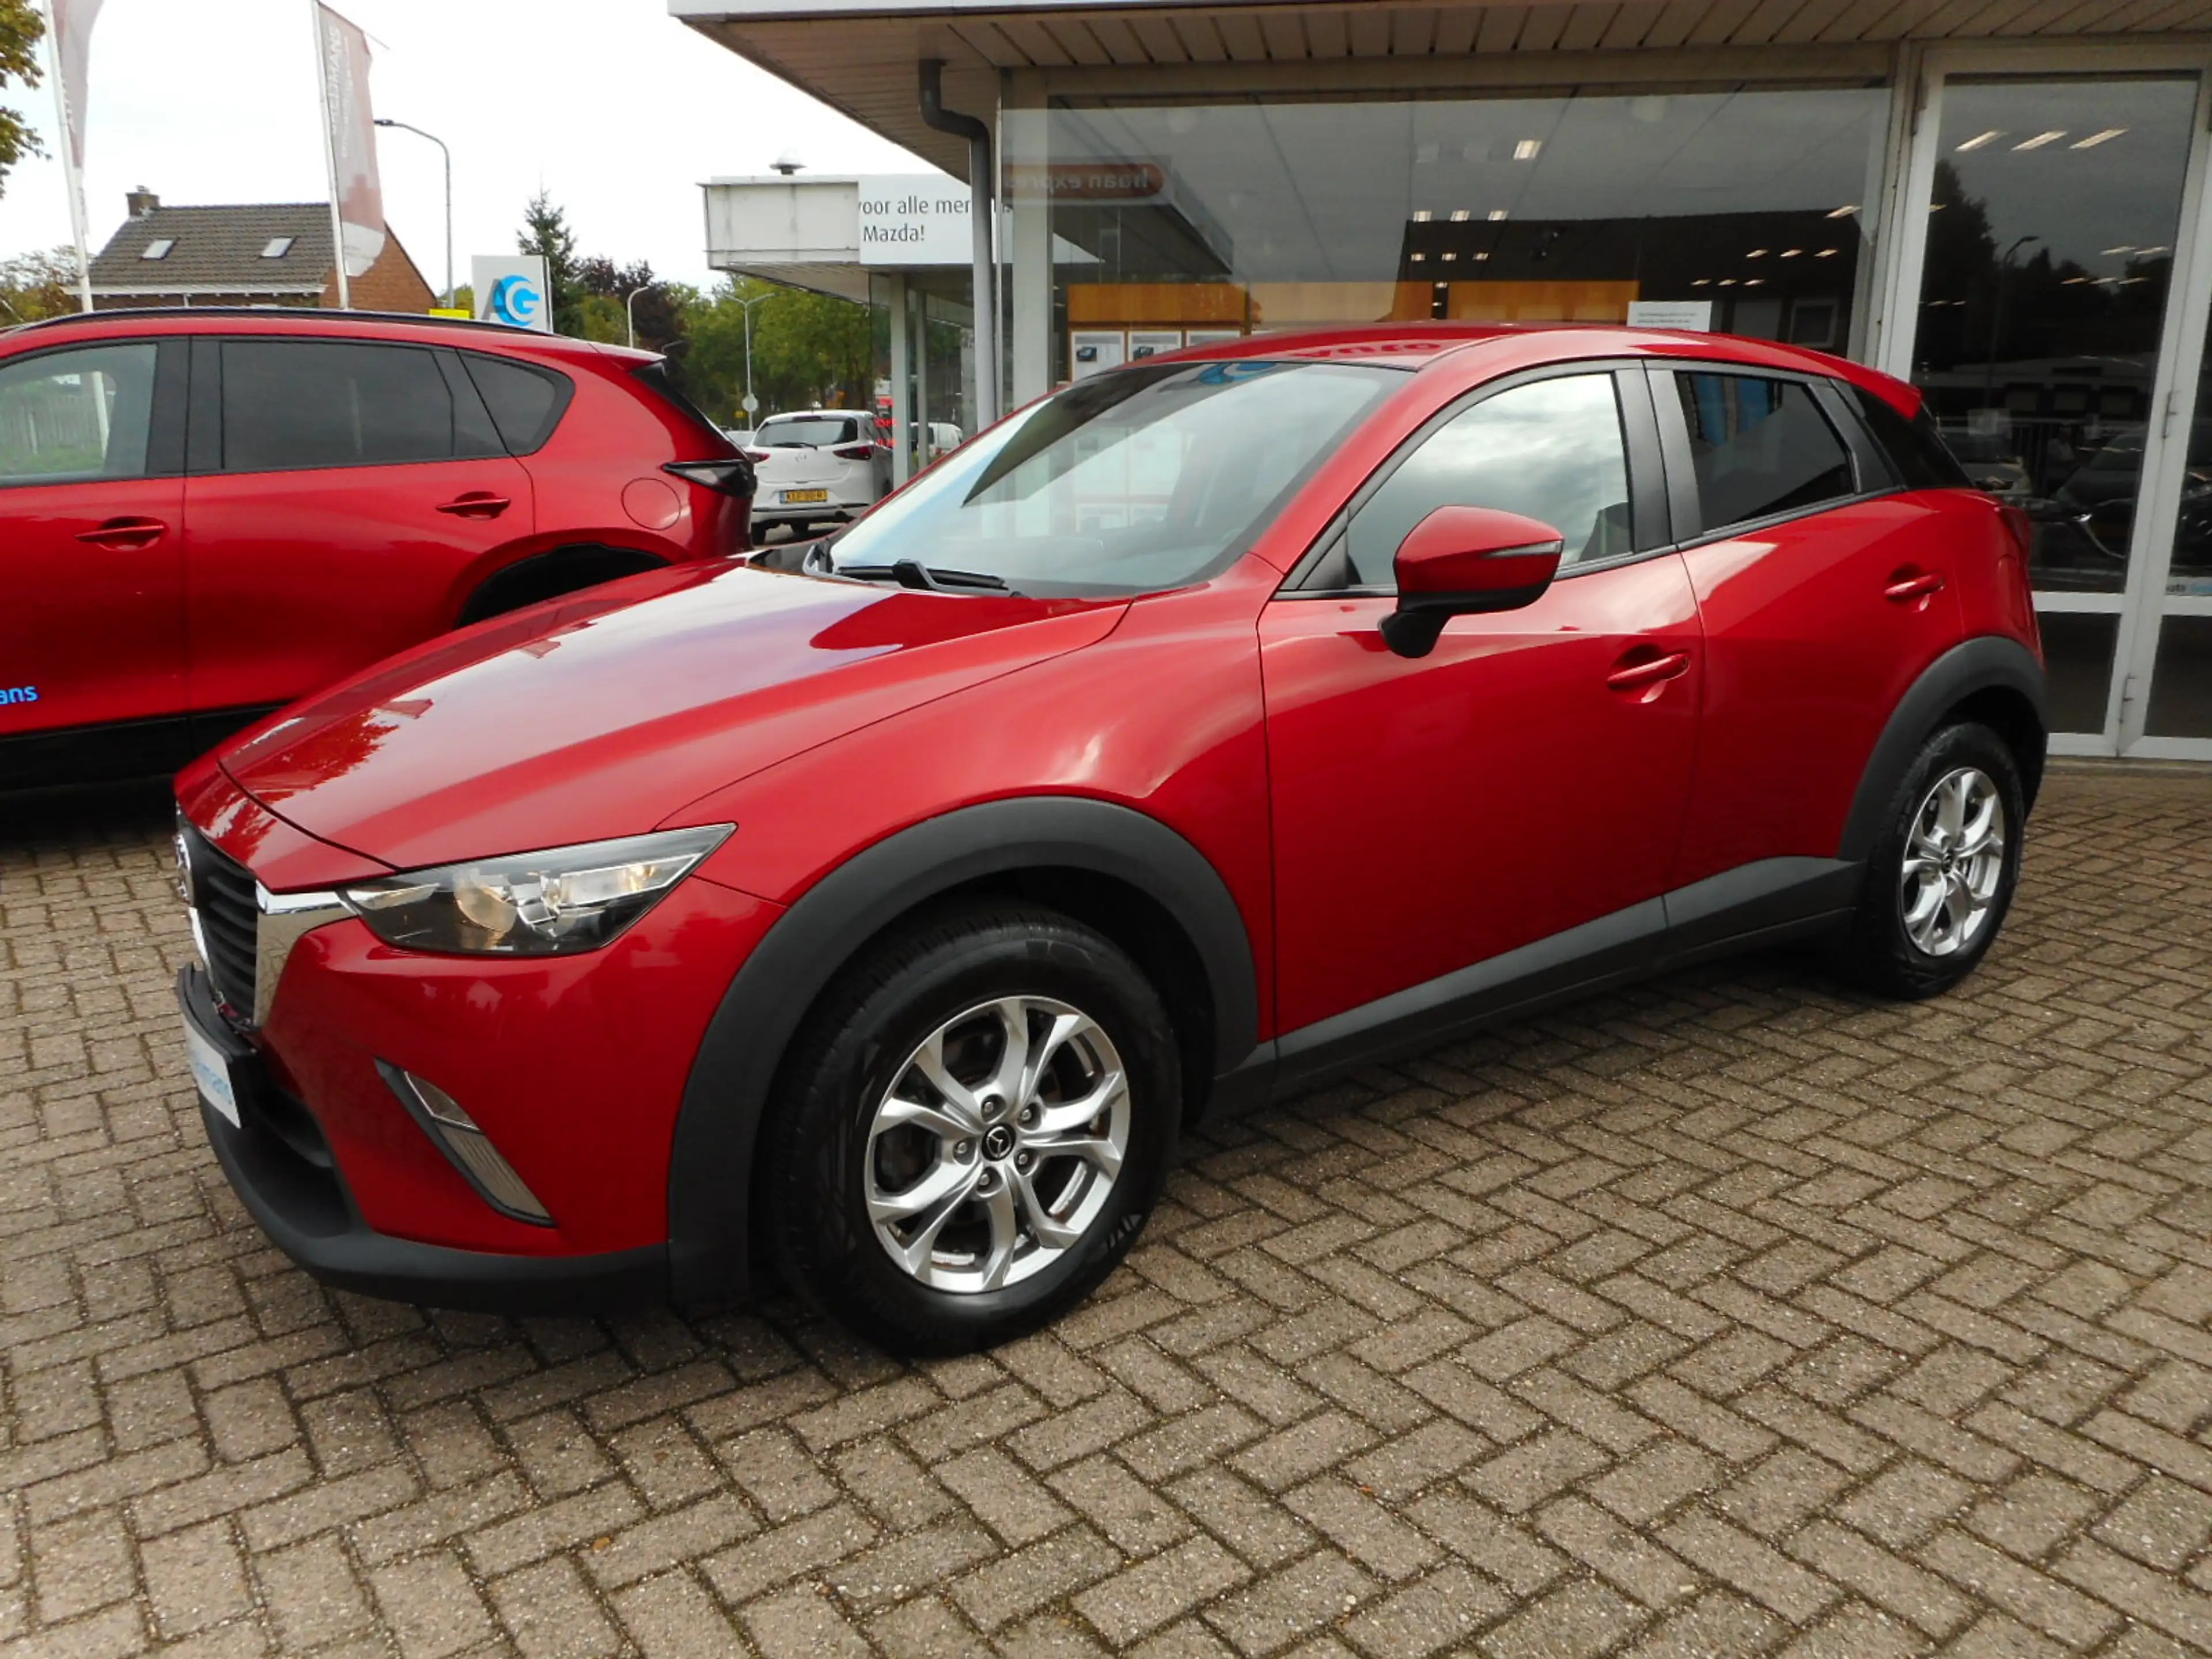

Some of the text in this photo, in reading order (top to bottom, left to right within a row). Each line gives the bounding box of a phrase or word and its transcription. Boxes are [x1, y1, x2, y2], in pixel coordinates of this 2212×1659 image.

[897, 195, 929, 214] alle
[935, 199, 972, 214] mer
[863, 224, 925, 242] Mazda!
